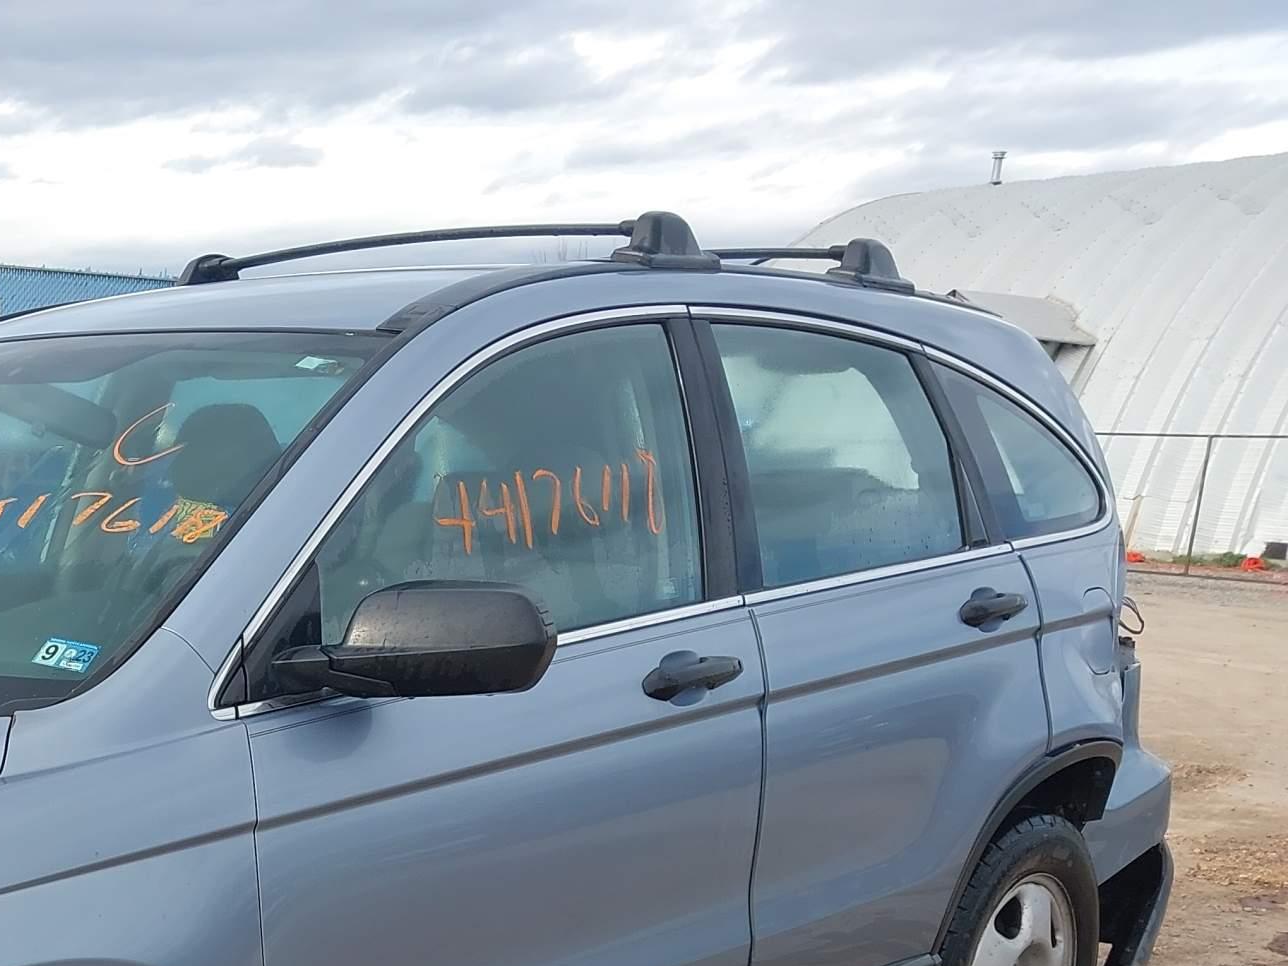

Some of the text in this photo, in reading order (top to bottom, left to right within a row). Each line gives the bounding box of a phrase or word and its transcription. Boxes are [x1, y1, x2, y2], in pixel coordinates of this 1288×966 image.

[113, 402, 185, 465] C
[41, 644, 94, 663] 9 23
